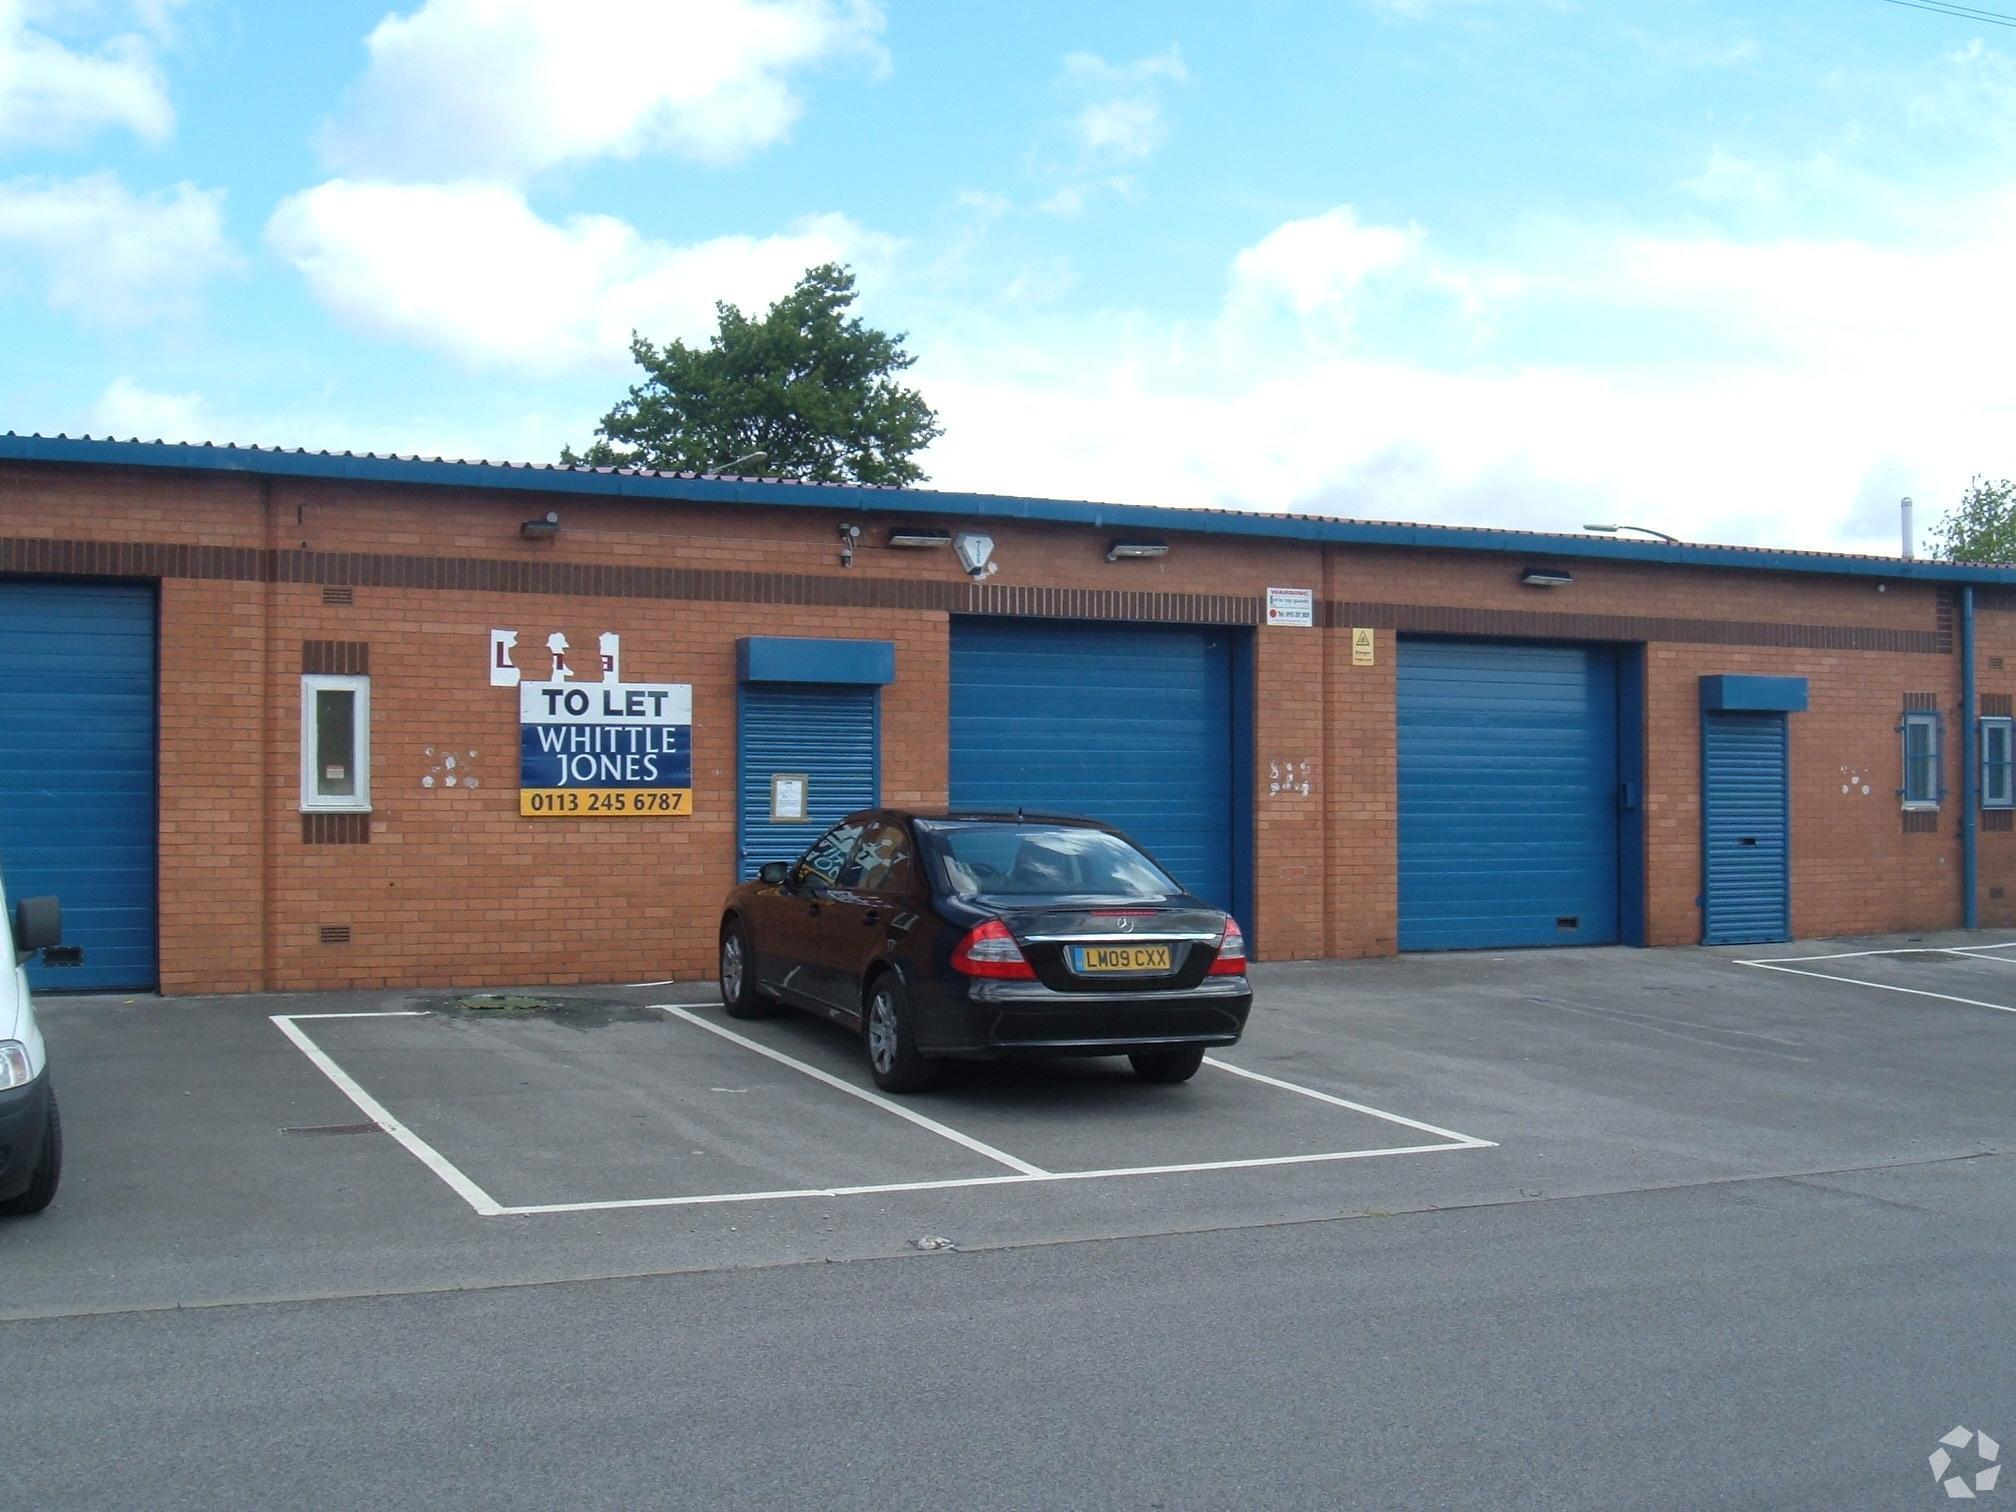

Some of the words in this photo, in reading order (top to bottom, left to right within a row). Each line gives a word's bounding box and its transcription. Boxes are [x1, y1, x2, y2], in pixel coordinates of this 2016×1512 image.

[541, 688, 590, 716] TO
[603, 690, 669, 717] LET
[537, 726, 677, 753] WHITTLE
[556, 753, 658, 786] JONES
[531, 793, 579, 811] 0113
[588, 793, 626, 811] 245
[633, 793, 683, 811] 6787
[1086, 950, 1131, 968] LM09
[1134, 949, 1167, 967] CXX
